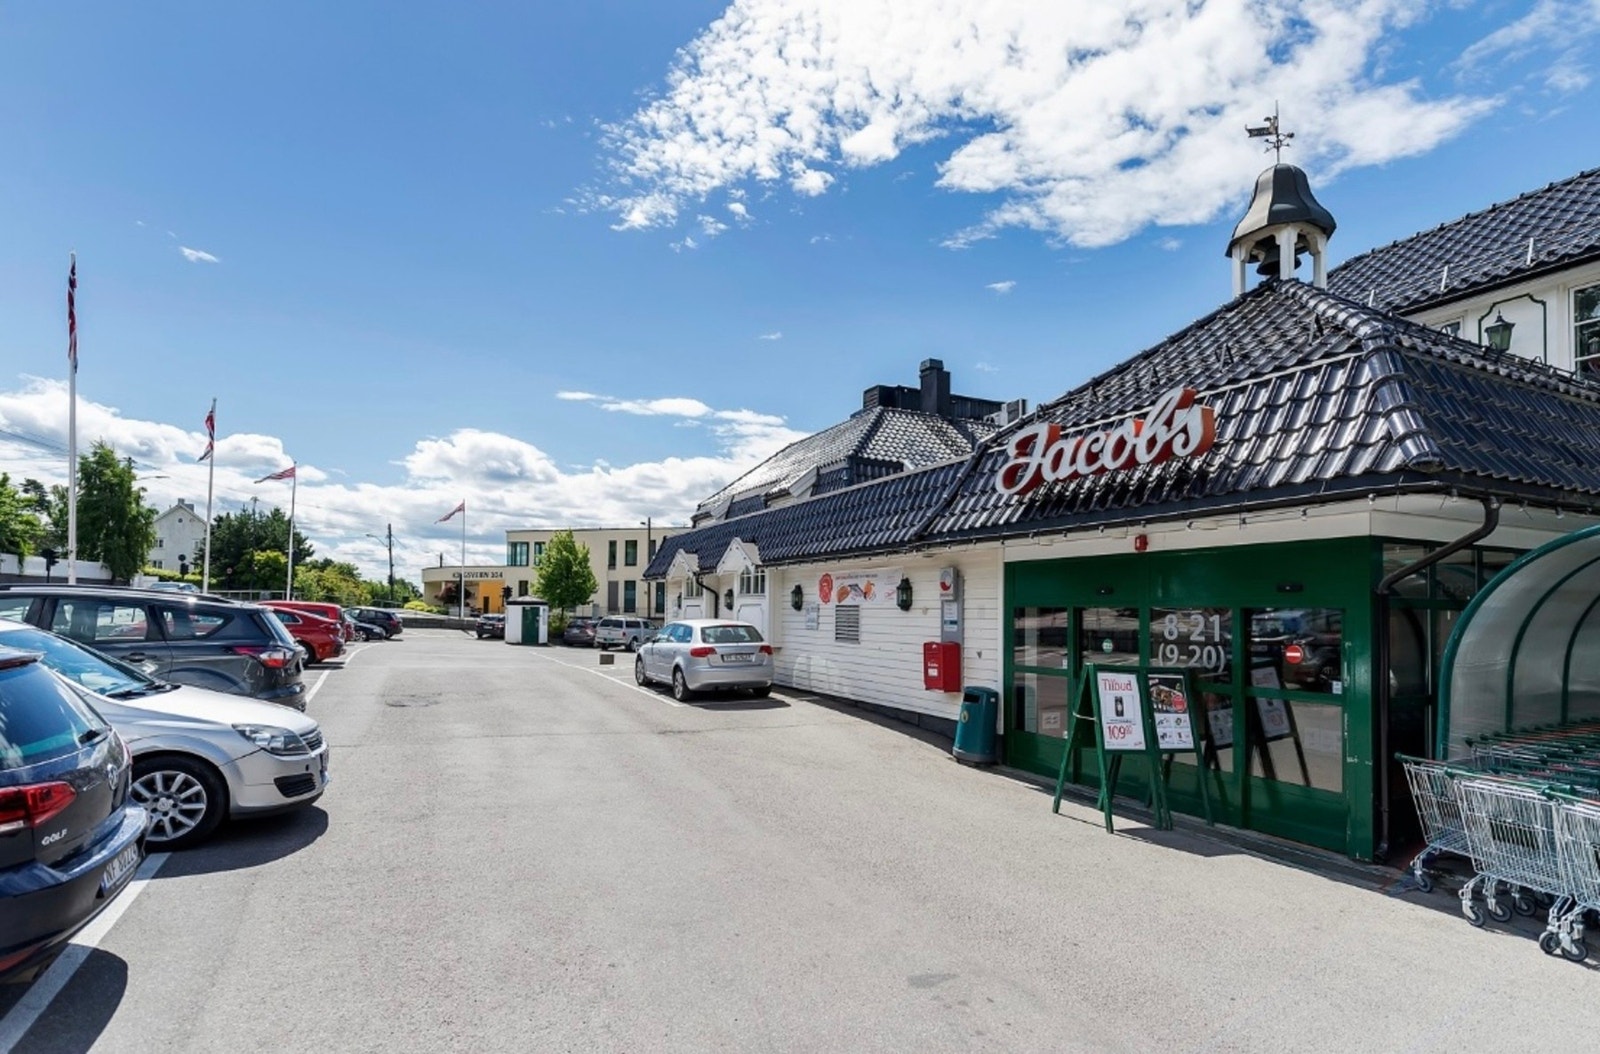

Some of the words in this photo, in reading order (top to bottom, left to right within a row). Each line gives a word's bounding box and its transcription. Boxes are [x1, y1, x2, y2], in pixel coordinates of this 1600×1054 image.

[1163, 613, 1221, 642] 8-21
[1158, 643, 1226, 673] (9-20)
[1102, 678, 1133, 691] Tilbud
[41, 828, 68, 846] GOLF
